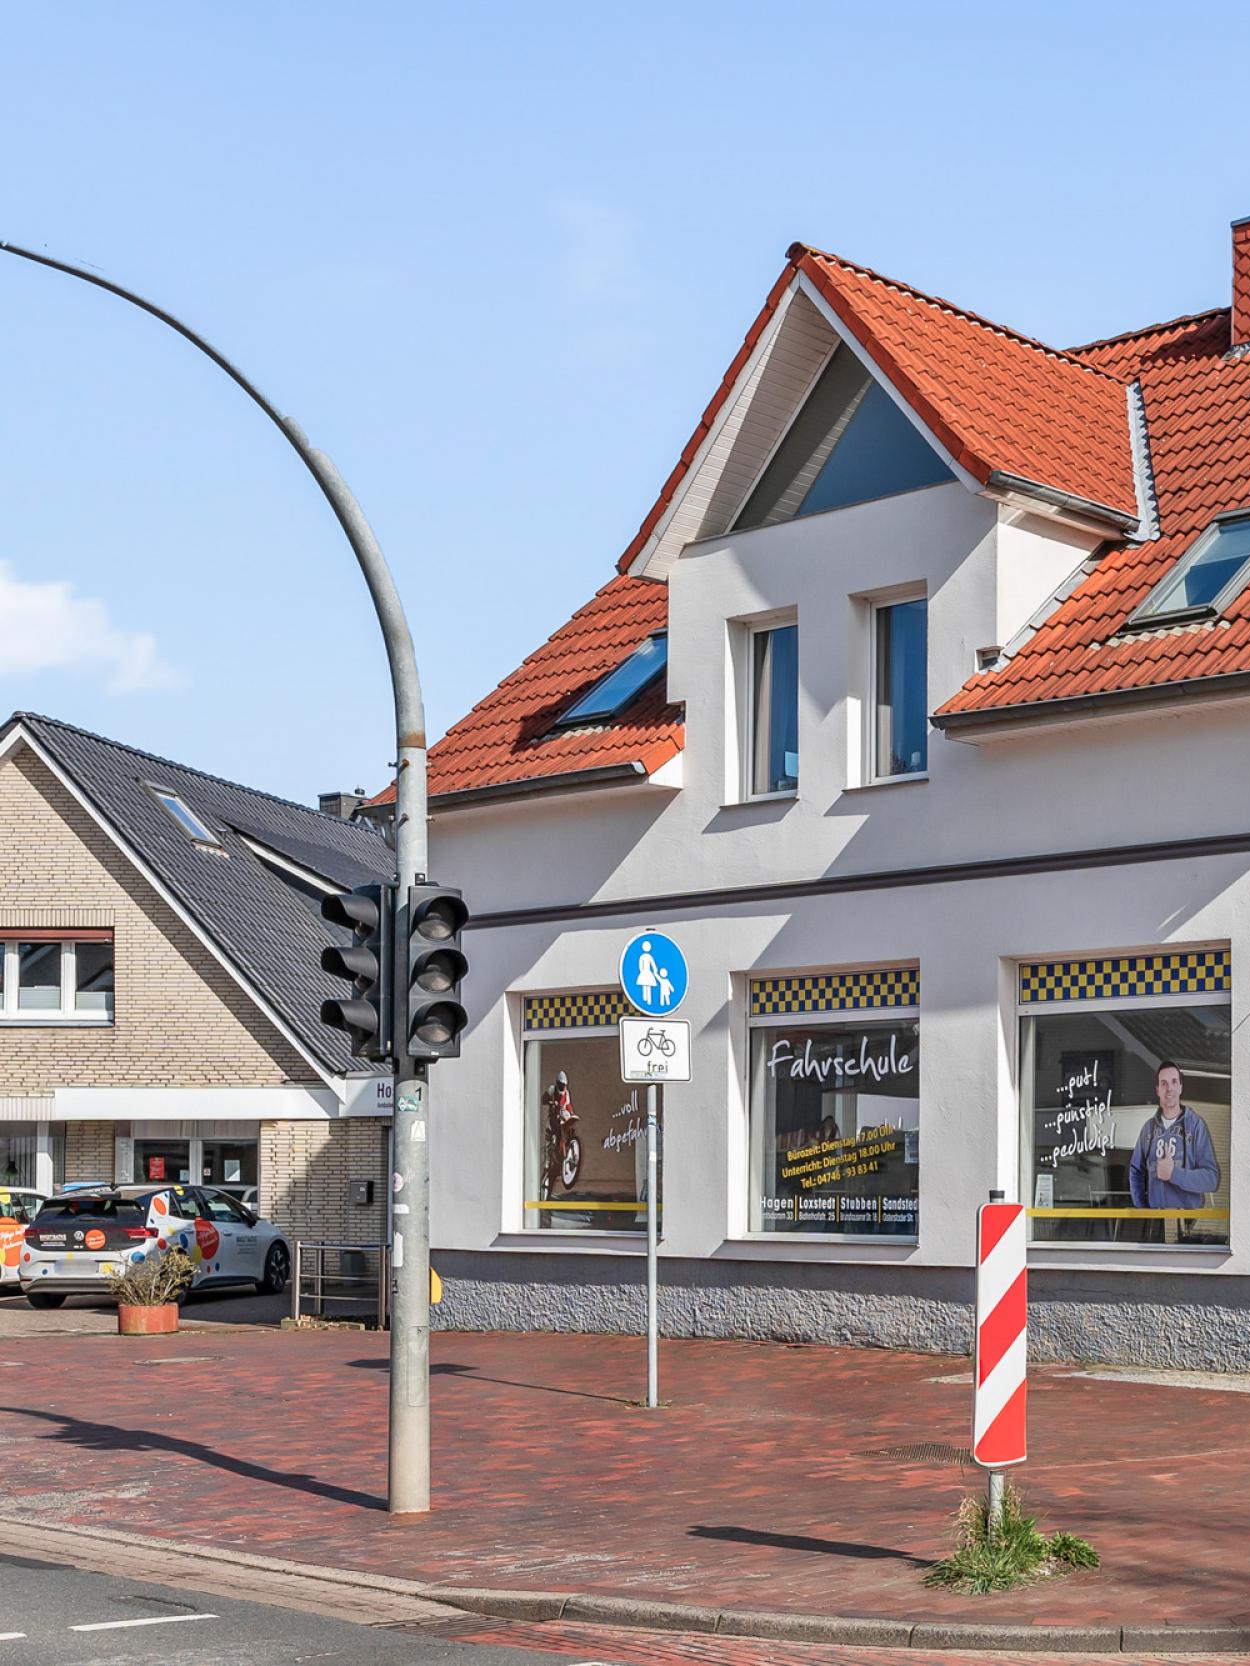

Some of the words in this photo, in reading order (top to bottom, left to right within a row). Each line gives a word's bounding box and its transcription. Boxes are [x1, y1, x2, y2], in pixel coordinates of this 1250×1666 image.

[767, 1034, 914, 1082] Fahrschule
[647, 1060, 669, 1074] frei
[377, 1083, 393, 1098] Ho
[415, 1086, 422, 1102] 1
[821, 1136, 856, 1153] Dienstag
[781, 1158, 823, 1178] Unterricht:
[823, 1151, 857, 1168] Dienstag
[880, 1141, 897, 1153] Uhr
[817, 1169, 841, 1185] 04746
[760, 1195, 794, 1211] Hagen
[799, 1196, 836, 1210] Loxstedt
[840, 1197, 877, 1210] Stubben
[882, 1197, 918, 1211] Sandsted
